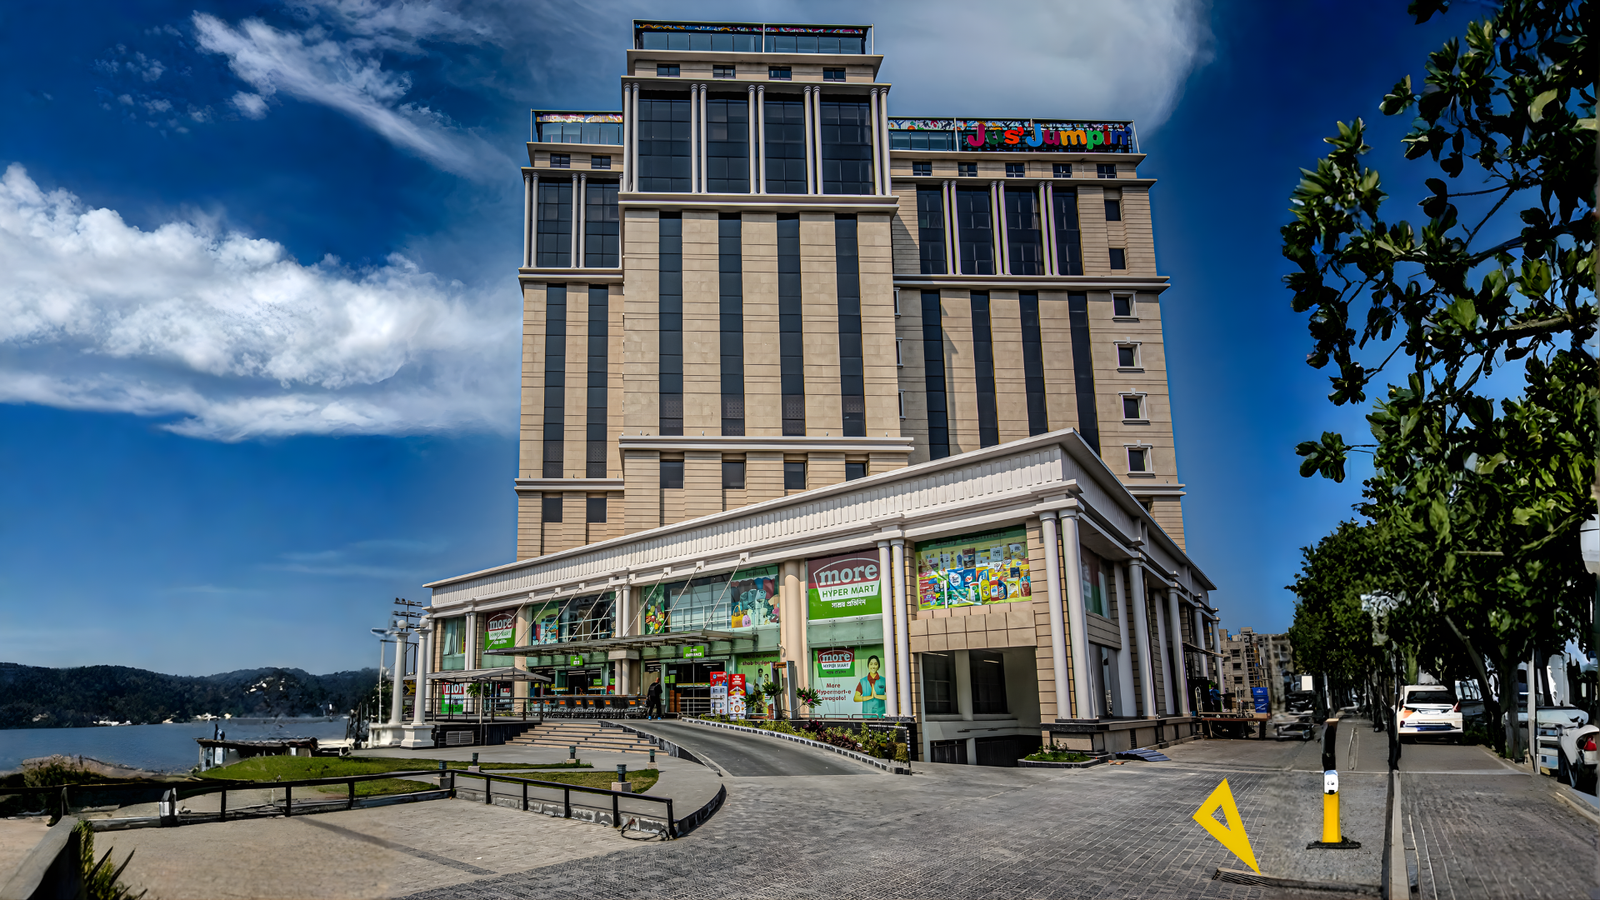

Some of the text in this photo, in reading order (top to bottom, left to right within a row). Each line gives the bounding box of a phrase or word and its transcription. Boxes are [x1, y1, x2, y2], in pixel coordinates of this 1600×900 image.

[819, 564, 878, 586] more
[822, 585, 875, 598] HYPER MART
[489, 618, 512, 630] more
[822, 653, 850, 662] more
